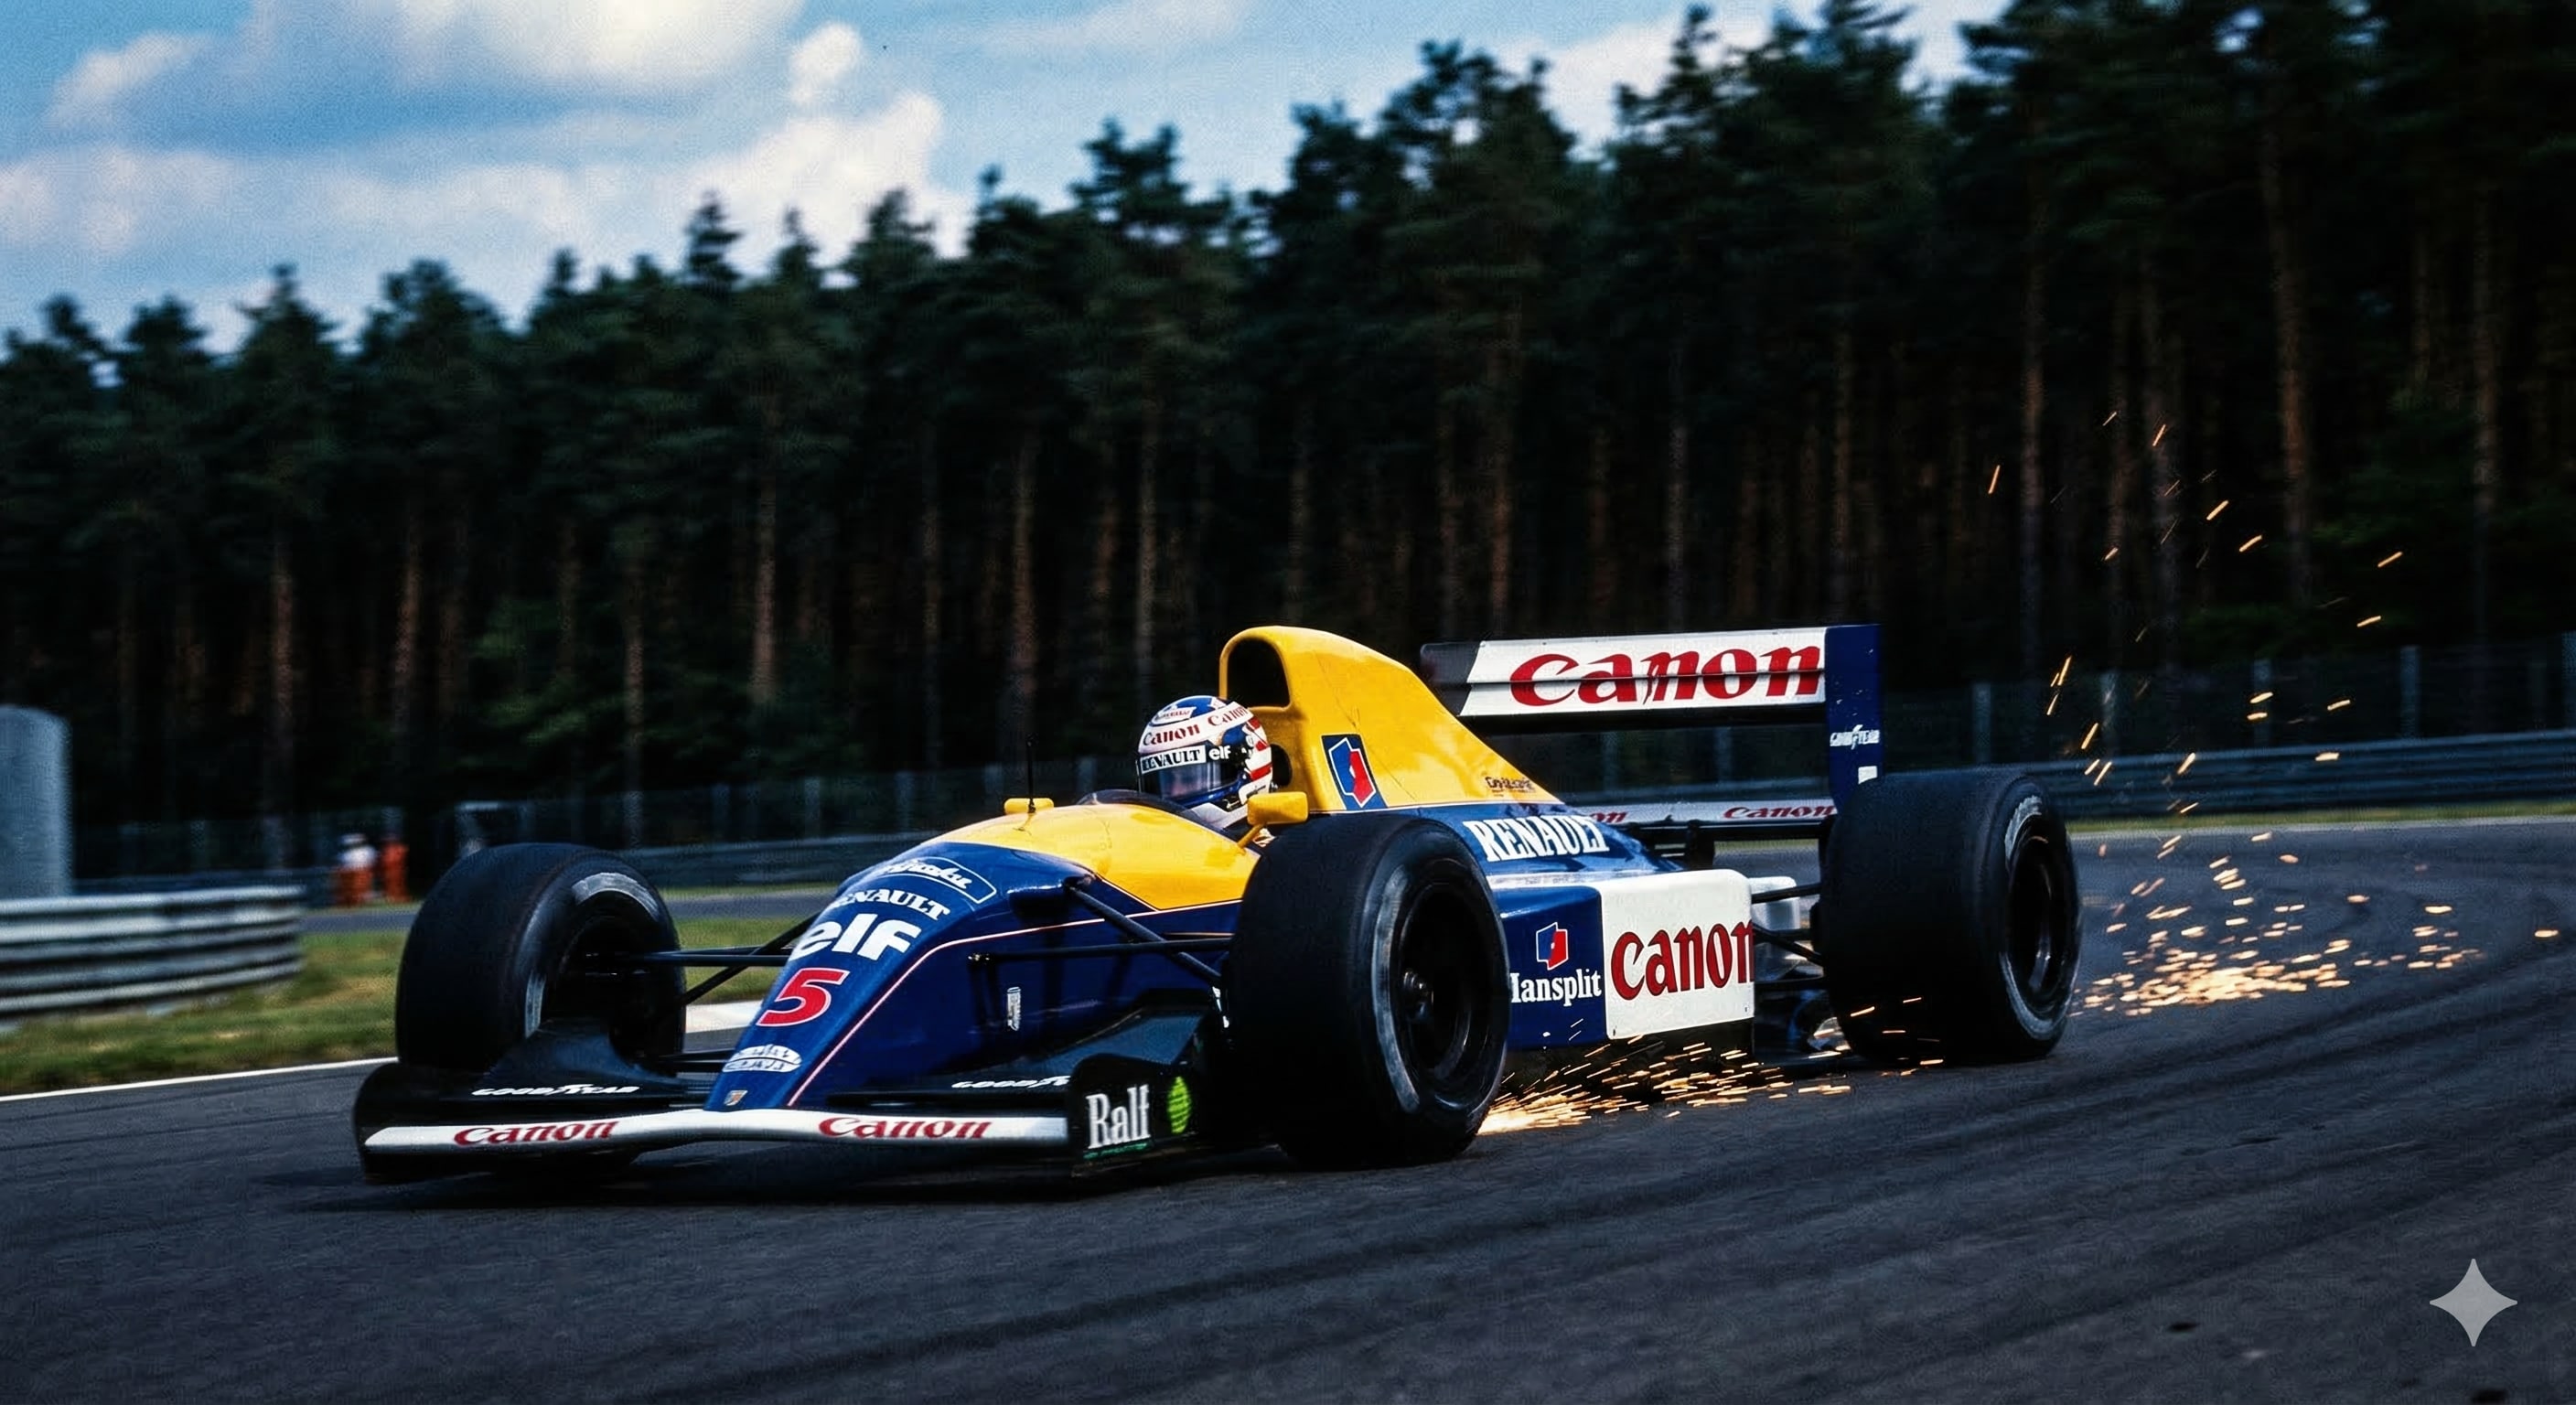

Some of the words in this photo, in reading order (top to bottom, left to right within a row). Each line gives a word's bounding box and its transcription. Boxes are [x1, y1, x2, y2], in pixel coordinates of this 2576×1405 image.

[1509, 646, 1820, 706] Canon
[1143, 724, 1200, 746] Canon
[1208, 745, 1231, 760] elf
[1723, 805, 1835, 820] Canon
[1463, 815, 1609, 863] RENAULT
[788, 913, 921, 961] elf
[1611, 919, 1755, 1001] Canon
[756, 967, 851, 1027] 5
[454, 1121, 619, 1145] Canon
[819, 1117, 992, 1139] Canon
[1085, 1084, 1152, 1150] Ralf
